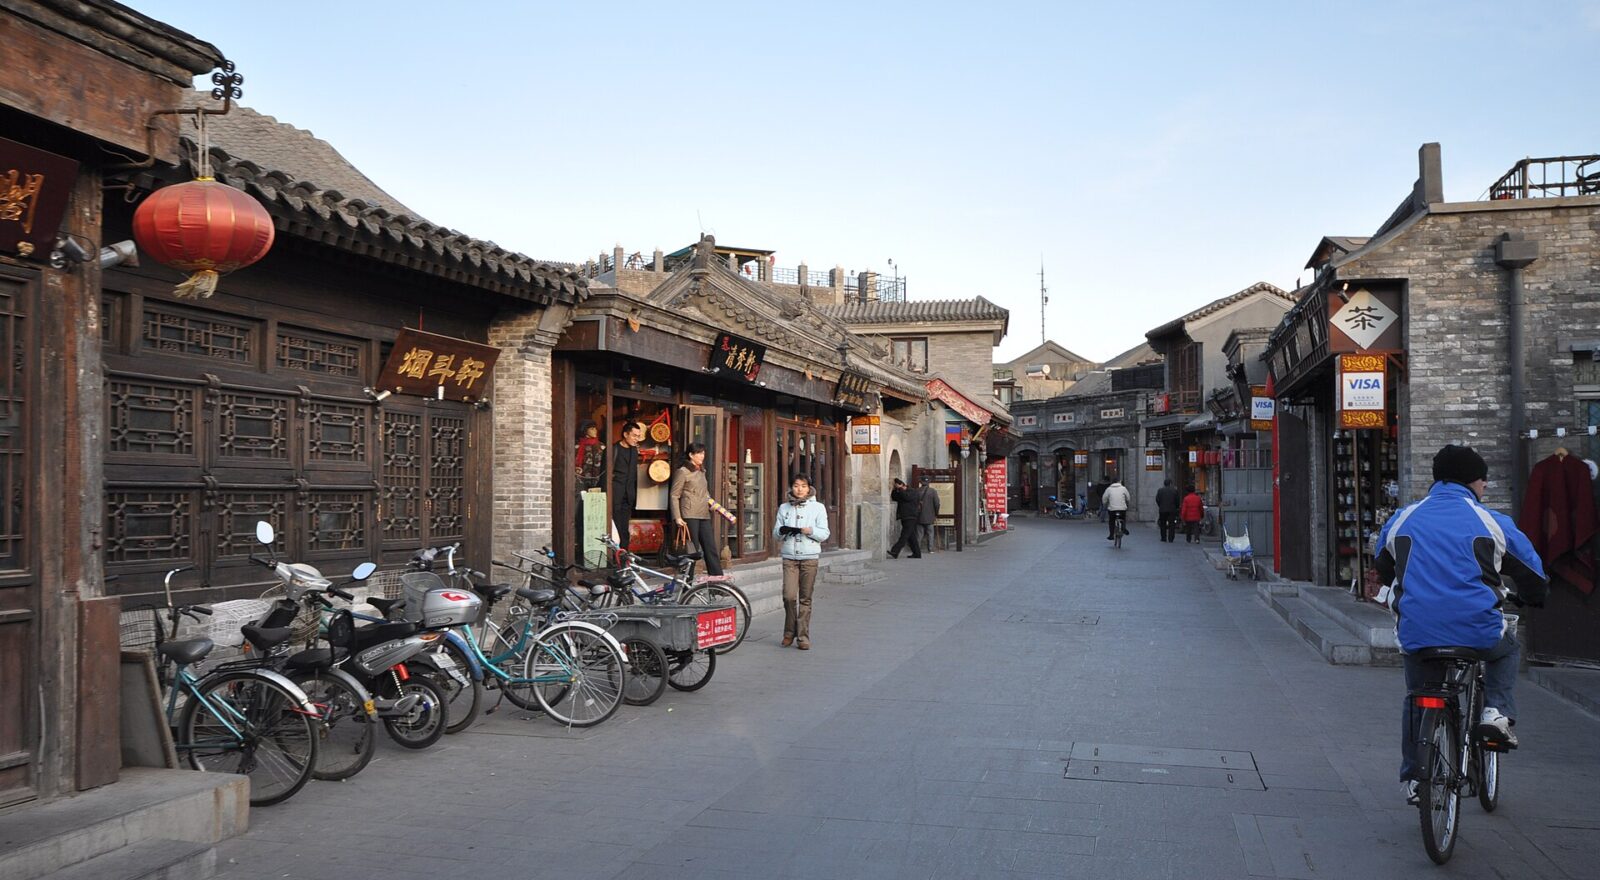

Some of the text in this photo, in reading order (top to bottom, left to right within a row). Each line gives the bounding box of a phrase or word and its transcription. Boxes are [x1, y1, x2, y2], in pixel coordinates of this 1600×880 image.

[1345, 306, 1384, 331] 茶
[1348, 379, 1380, 389] VISA
[1255, 401, 1272, 409] VISA
